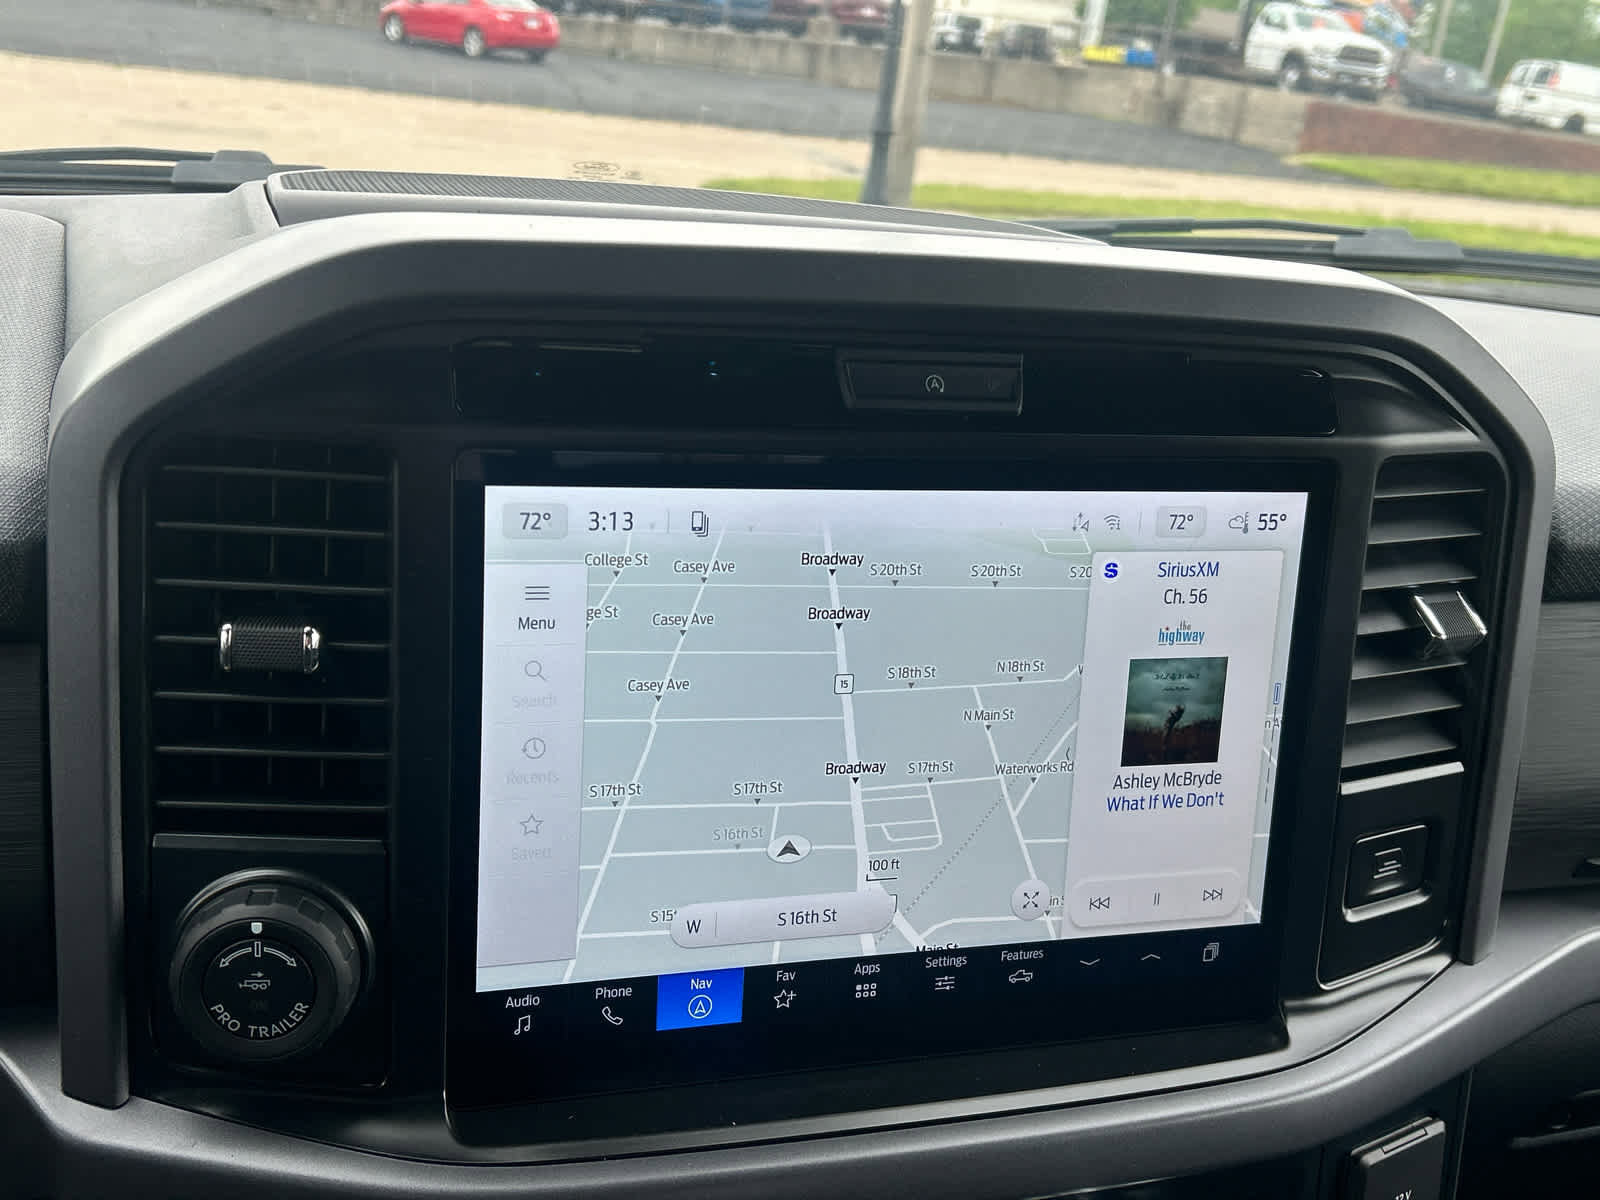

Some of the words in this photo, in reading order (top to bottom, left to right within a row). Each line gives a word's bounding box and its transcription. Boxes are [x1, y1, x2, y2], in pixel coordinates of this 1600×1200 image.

[519, 512, 552, 531] 72°
[587, 511, 634, 532] 3:13
[1169, 514, 1194, 530] 72°
[1257, 513, 1288, 531] 55°
[584, 553, 632, 569] College
[634, 553, 649, 567] St
[801, 553, 865, 568] Broadway
[673, 561, 709, 576] Casey
[711, 561, 736, 574] Ave
[869, 564, 878, 577] S
[879, 564, 907, 577] 20th
[909, 563, 922, 576] St
[970, 565, 979, 578] S
[980, 565, 1007, 578] 20th
[1009, 565, 1022, 578] St
[1069, 567, 1078, 579] S
[1157, 561, 1220, 578] SiriusXM
[1163, 588, 1186, 605] Ch.
[1189, 588, 1208, 605] 56
[604, 606, 619, 619] St
[808, 607, 871, 622] Broadway
[518, 617, 556, 631] Menu
[652, 613, 689, 629] Casey
[690, 613, 714, 626] Ave
[1179, 621, 1192, 632] the
[1158, 628, 1205, 646] highway
[887, 668, 896, 680] S
[898, 667, 922, 680] 18th
[923, 666, 937, 679] St
[996, 662, 1006, 674] N
[1007, 661, 1031, 673] 18th
[1033, 660, 1045, 672] St
[627, 680, 664, 696] Casey
[666, 679, 690, 692] Ave
[839, 679, 849, 690] 15
[964, 711, 972, 722] N
[973, 710, 1000, 722] Main
[1002, 709, 1015, 721] St
[825, 762, 887, 778] Broadway
[908, 762, 916, 774] S
[917, 761, 940, 774] 17th
[941, 761, 954, 773] St
[995, 763, 1059, 776] Waterworks
[1060, 760, 1075, 774] Rd
[1112, 773, 1161, 791] Ashley
[1163, 770, 1223, 788] McBryde
[589, 785, 598, 797] S
[600, 784, 625, 797] 17th
[628, 783, 642, 796] St
[733, 784, 742, 796] S
[743, 783, 767, 796] 17th
[769, 781, 783, 794] St
[1107, 796, 1145, 812] What
[1148, 794, 1161, 810] If
[1162, 793, 1184, 809] We
[1186, 791, 1225, 808] Don't
[713, 829, 721, 841] S
[723, 828, 749, 841] 16th
[750, 826, 764, 839] St
[868, 860, 888, 873] 100
[890, 858, 900, 871] ft
[651, 910, 659, 923] S
[686, 919, 702, 934] W
[777, 912, 787, 926] S
[789, 911, 820, 926] 16th
[822, 909, 837, 923] St
[925, 955, 968, 969] Settings
[1001, 948, 1045, 962] Features
[776, 969, 797, 982] Fav
[854, 961, 881, 976] Apps
[690, 977, 713, 990] Nav
[595, 985, 633, 1000] Phone
[505, 994, 541, 1009] Audio
[210, 1003, 241, 1033] PRO
[247, 1001, 311, 1039] TRAILER
